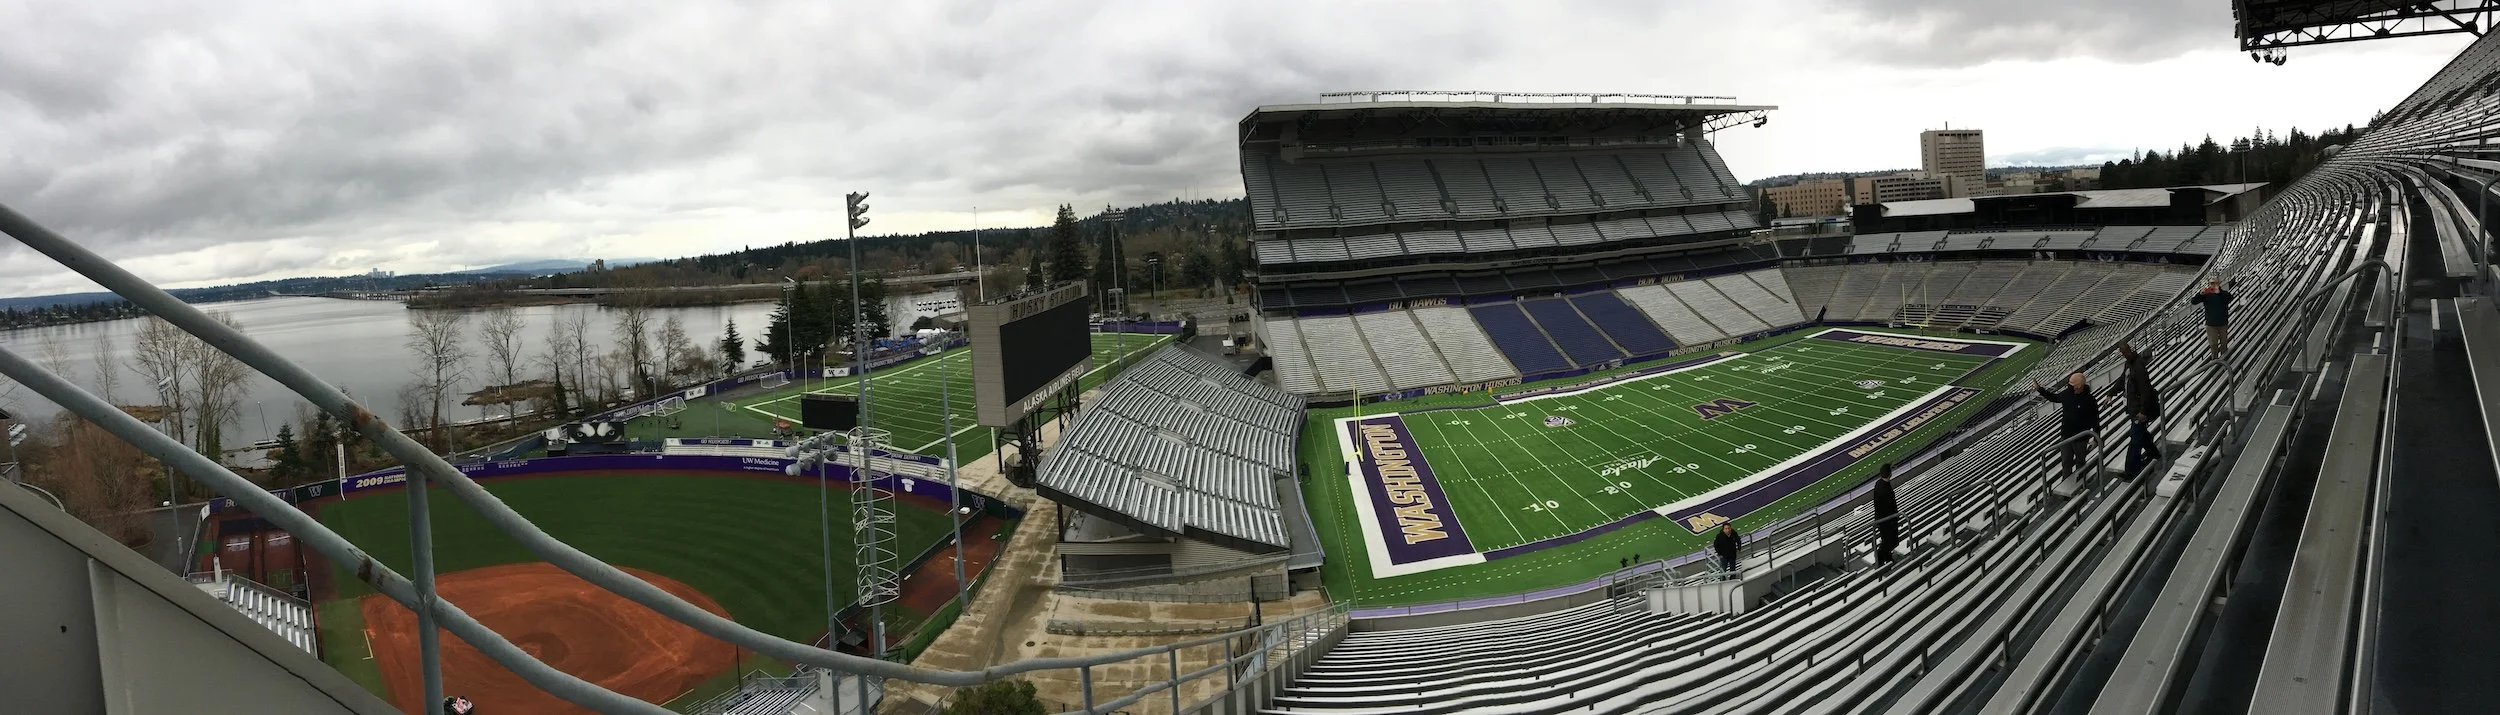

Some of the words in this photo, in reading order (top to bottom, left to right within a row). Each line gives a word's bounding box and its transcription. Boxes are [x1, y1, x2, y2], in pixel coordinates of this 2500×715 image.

[1010, 295, 1046, 319] HUSKY
[1050, 284, 1082, 307] STADIUM
[1668, 343, 1713, 357] WASHINGTON
[1714, 337, 1742, 349] HUSKIES
[1023, 388, 1048, 413] ALASKA
[1048, 372, 1071, 397] AIRLINES
[1071, 364, 1085, 380] FIELD
[1423, 383, 1482, 396] WASHINGTON
[1484, 377, 1522, 391] HUSKIES
[1783, 425, 1806, 434] 50
[1734, 443, 1757, 454] 40
[754, 458, 780, 466] Medicine
[1601, 455, 1663, 477] Alaska
[1672, 462, 1699, 474] 30
[355, 476, 384, 488] 2009
[1361, 423, 1449, 545] WASHINGTON
[1604, 481, 1633, 495] 20
[1529, 500, 1560, 513] 10
